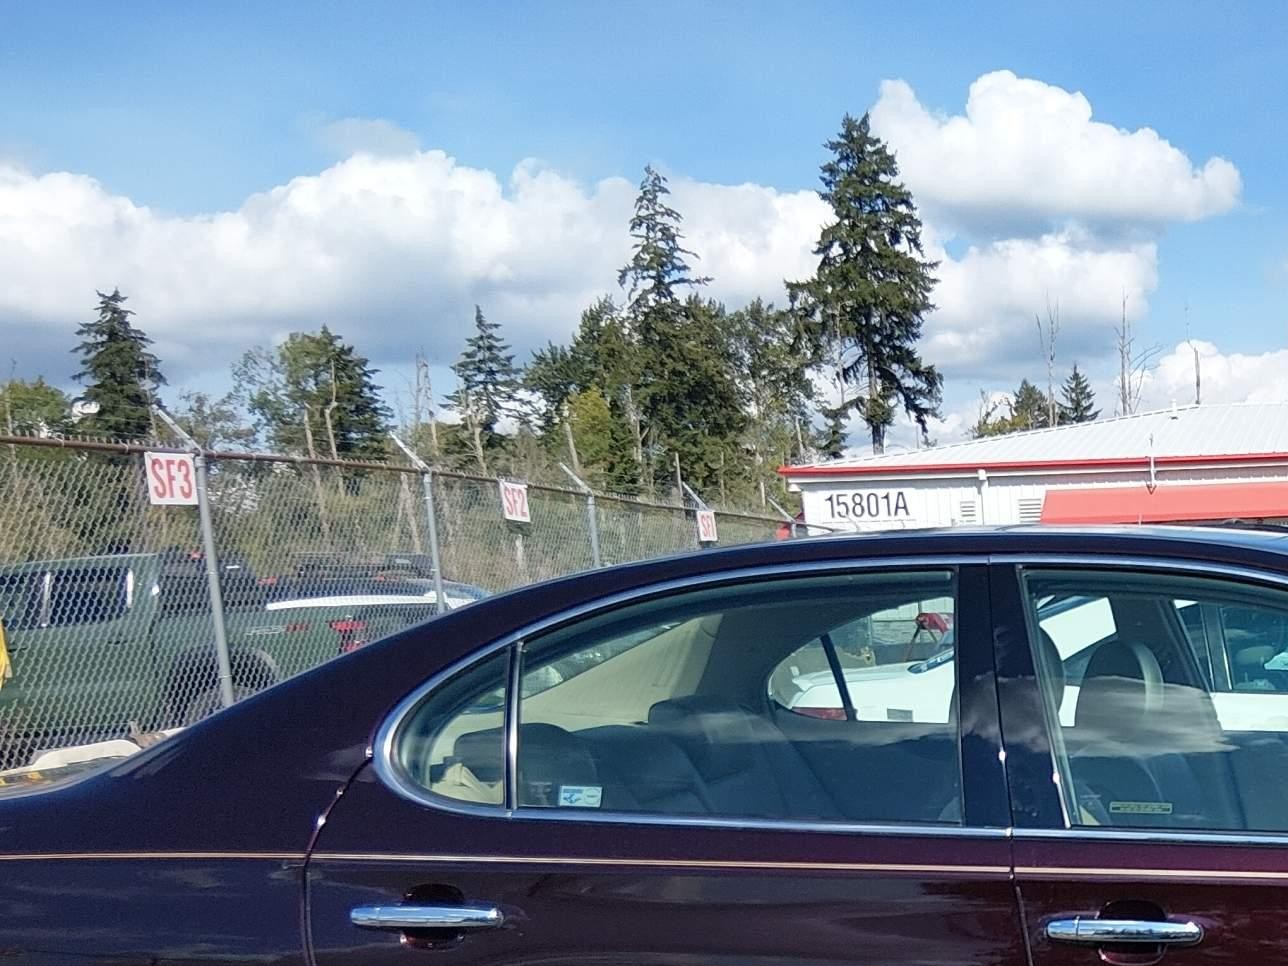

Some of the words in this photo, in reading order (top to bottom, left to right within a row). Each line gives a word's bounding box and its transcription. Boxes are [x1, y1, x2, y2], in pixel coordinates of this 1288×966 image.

[151, 458, 193, 499] SF3
[504, 486, 528, 517] SF2
[824, 491, 910, 519] 15801A
[700, 513, 716, 538] SF1
